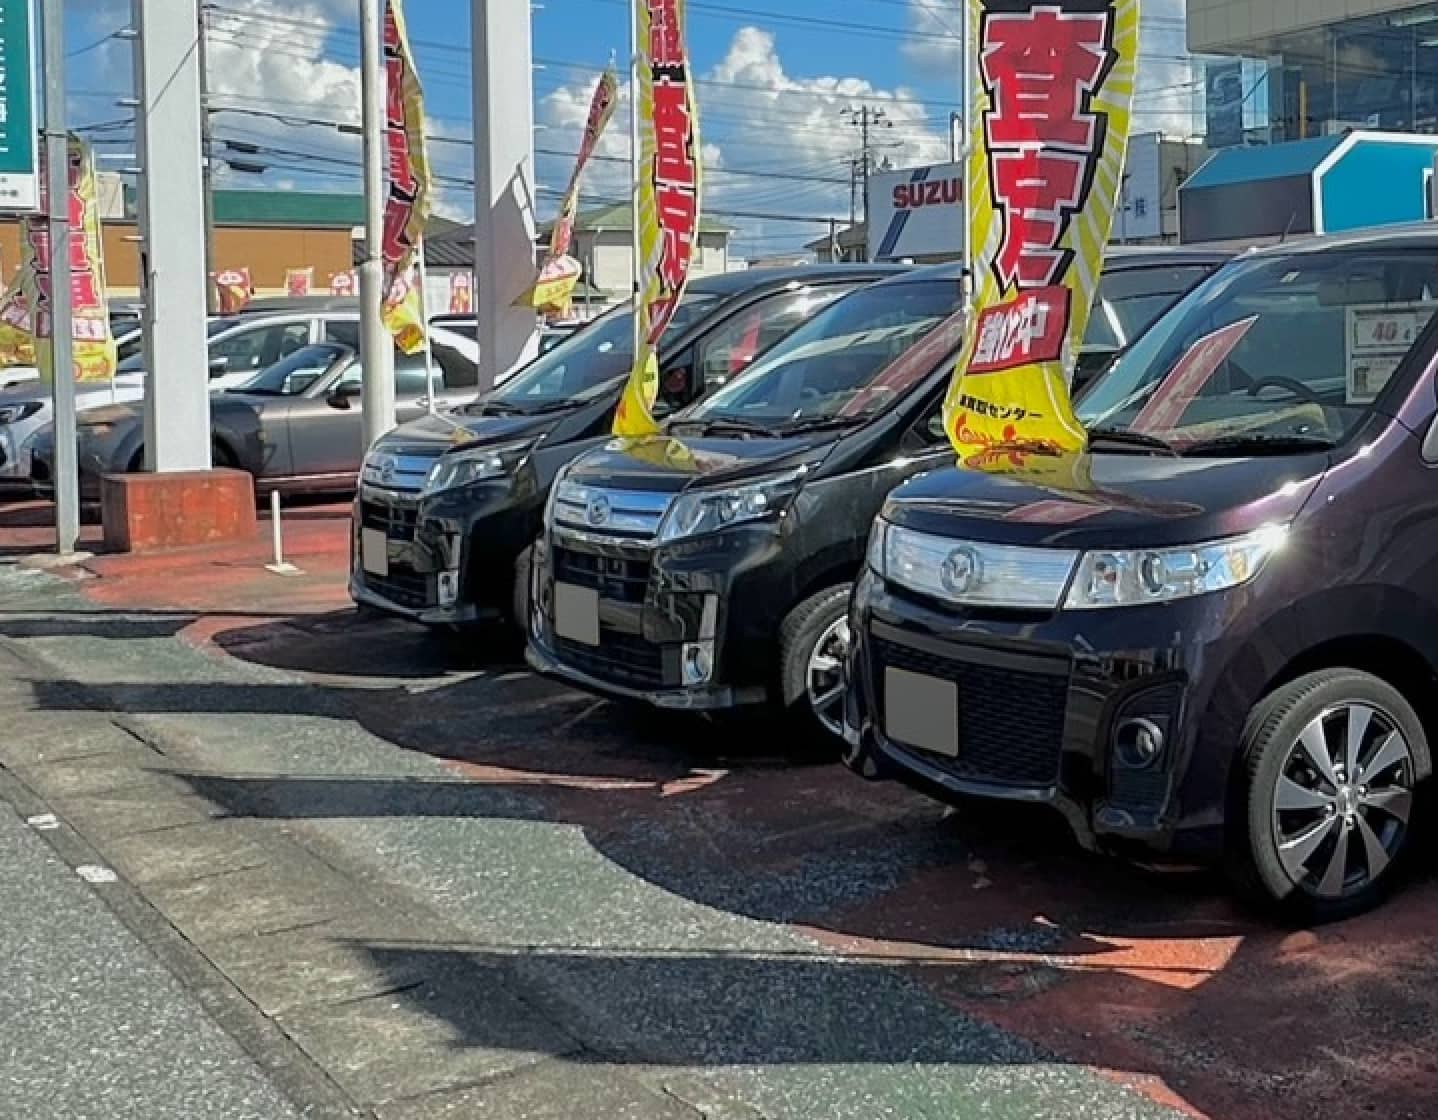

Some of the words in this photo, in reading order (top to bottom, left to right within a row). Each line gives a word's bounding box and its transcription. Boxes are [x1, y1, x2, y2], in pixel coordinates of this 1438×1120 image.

[978, 5, 1110, 290] 査定
[971, 295, 1051, 365] 強化中
